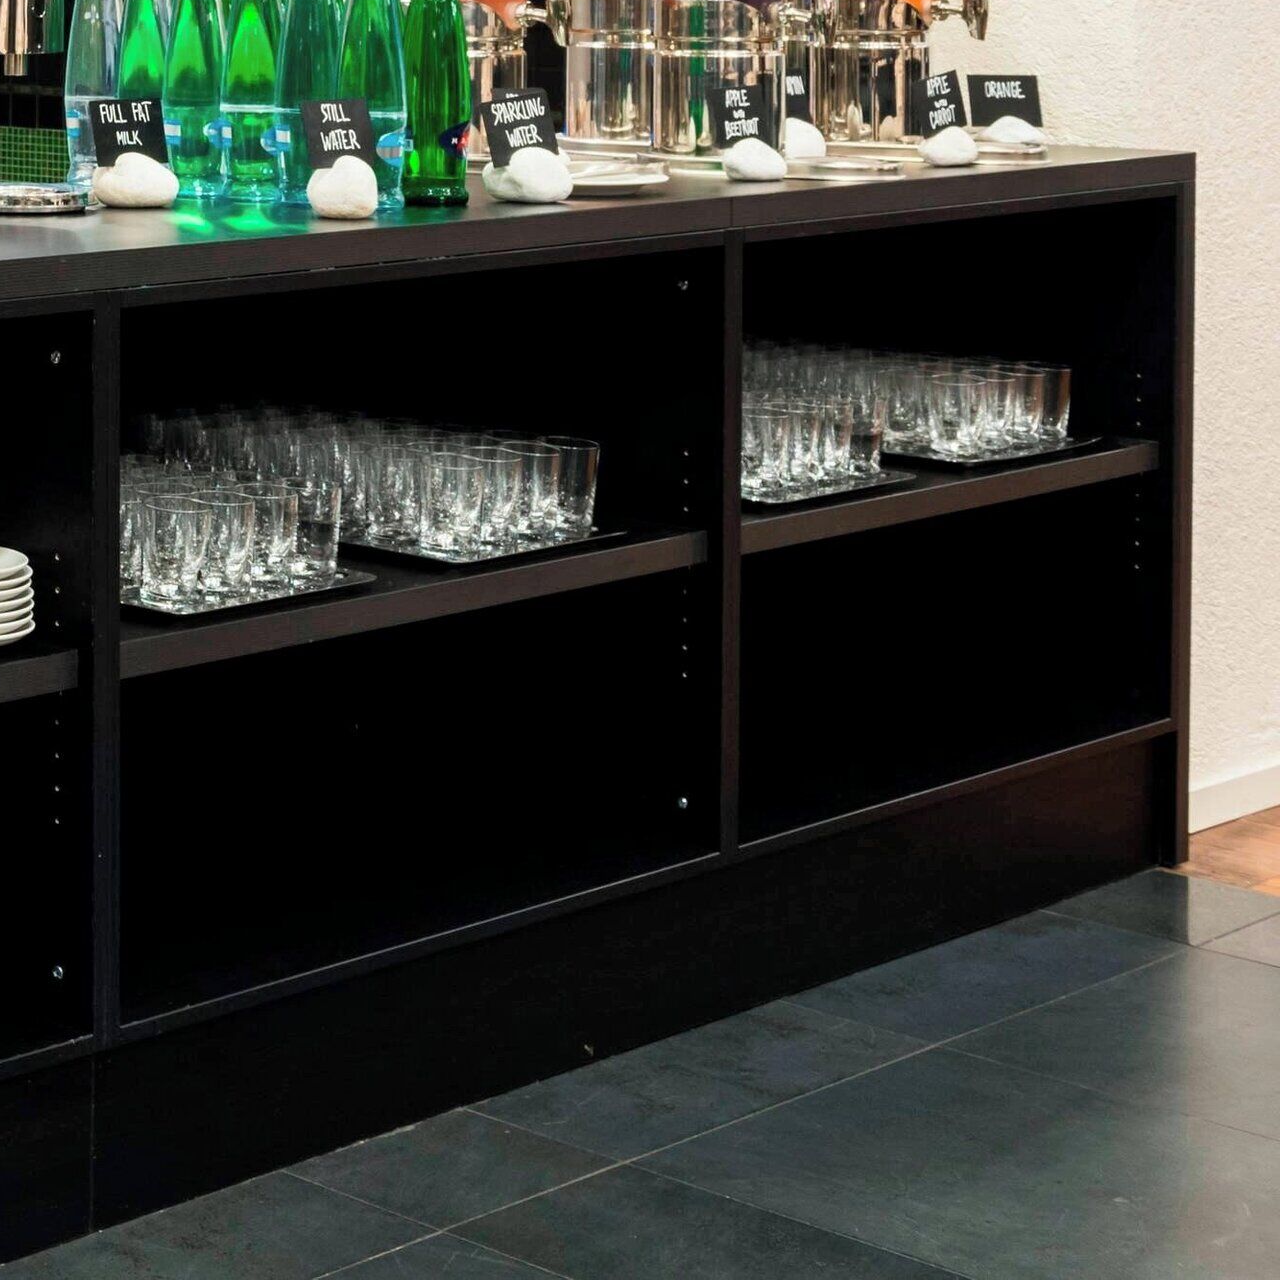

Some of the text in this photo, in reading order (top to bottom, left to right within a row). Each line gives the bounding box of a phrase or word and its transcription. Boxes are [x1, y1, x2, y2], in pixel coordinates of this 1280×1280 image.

[926, 75, 951, 98] APPLE
[984, 81, 1026, 99] ORANGE
[725, 89, 750, 108] APPLE
[99, 101, 152, 124] FULL FAT
[320, 103, 351, 123] STILL
[491, 97, 545, 126] SPARKLING
[929, 104, 956, 130] CARROT
[116, 130, 143, 146] MILK
[320, 128, 361, 152] WATER
[505, 124, 543, 148] WATER
[724, 117, 759, 140] BEETROOT
